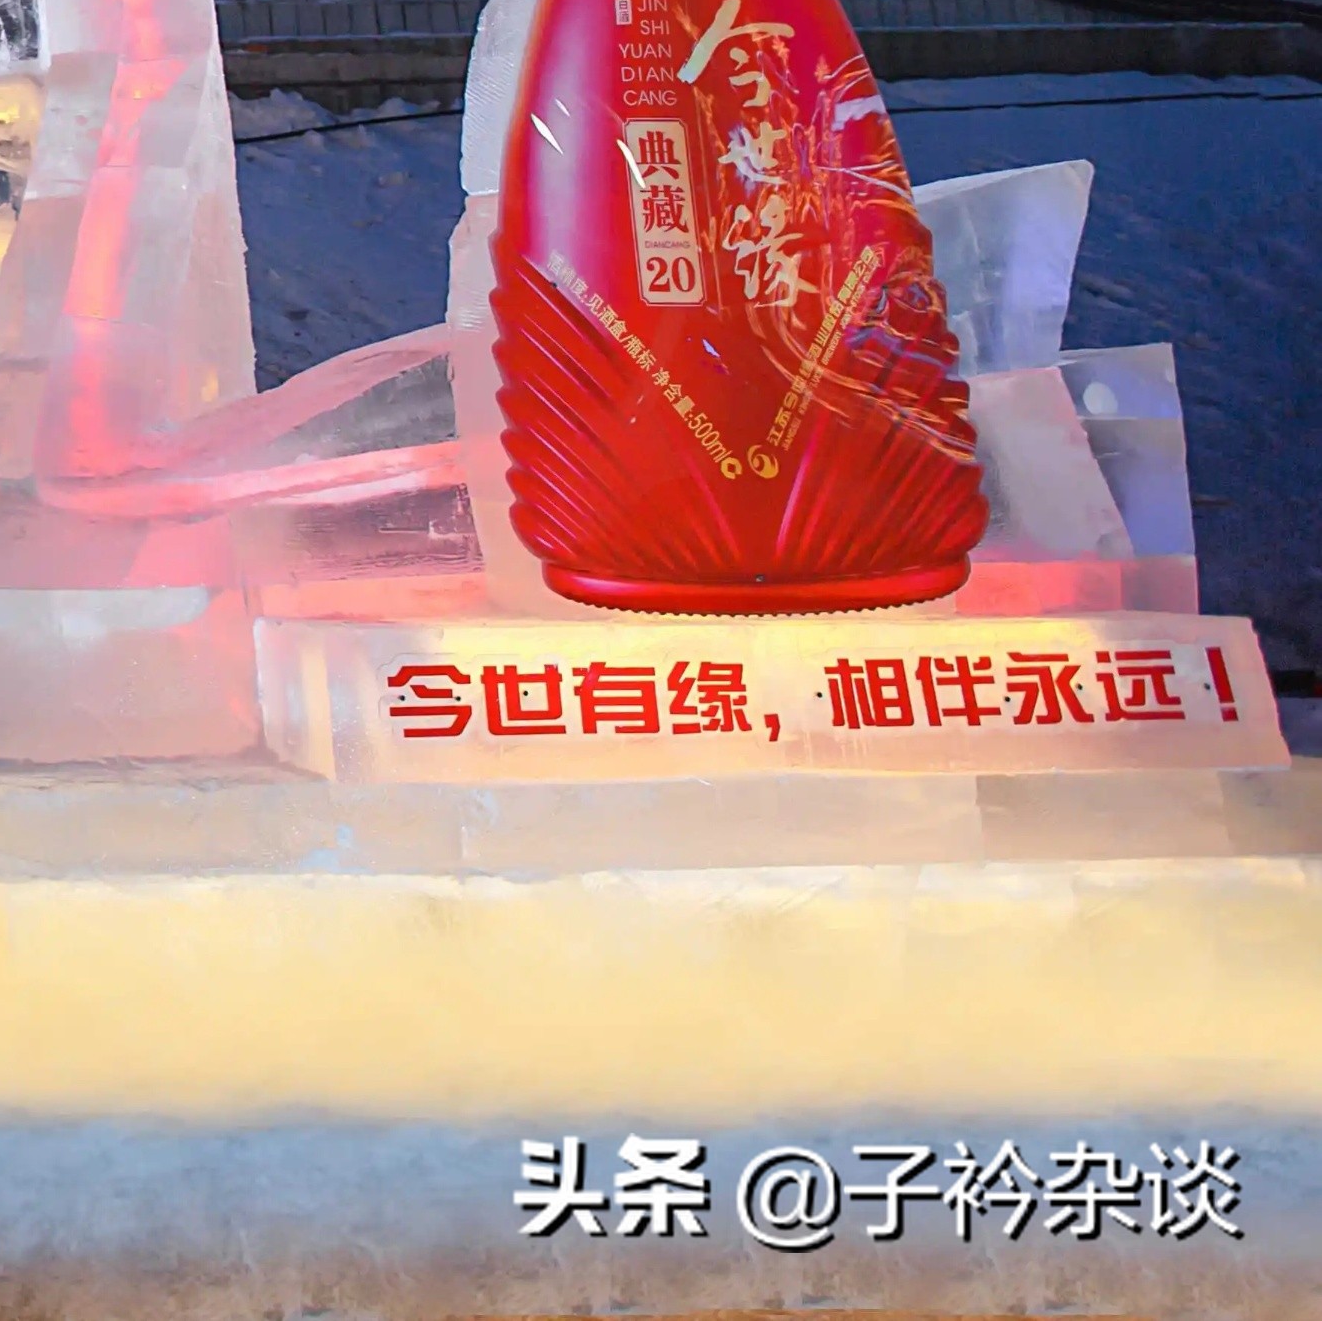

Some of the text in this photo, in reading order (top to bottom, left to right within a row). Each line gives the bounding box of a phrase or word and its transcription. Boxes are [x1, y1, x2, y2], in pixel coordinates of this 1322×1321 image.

[639, 19, 671, 35] SHI
[618, 42, 673, 59] YUAN
[620, 66, 675, 82] DIAN
[622, 89, 678, 107] CANG
[635, 131, 689, 234] 典藏
[646, 256, 696, 293] 20
